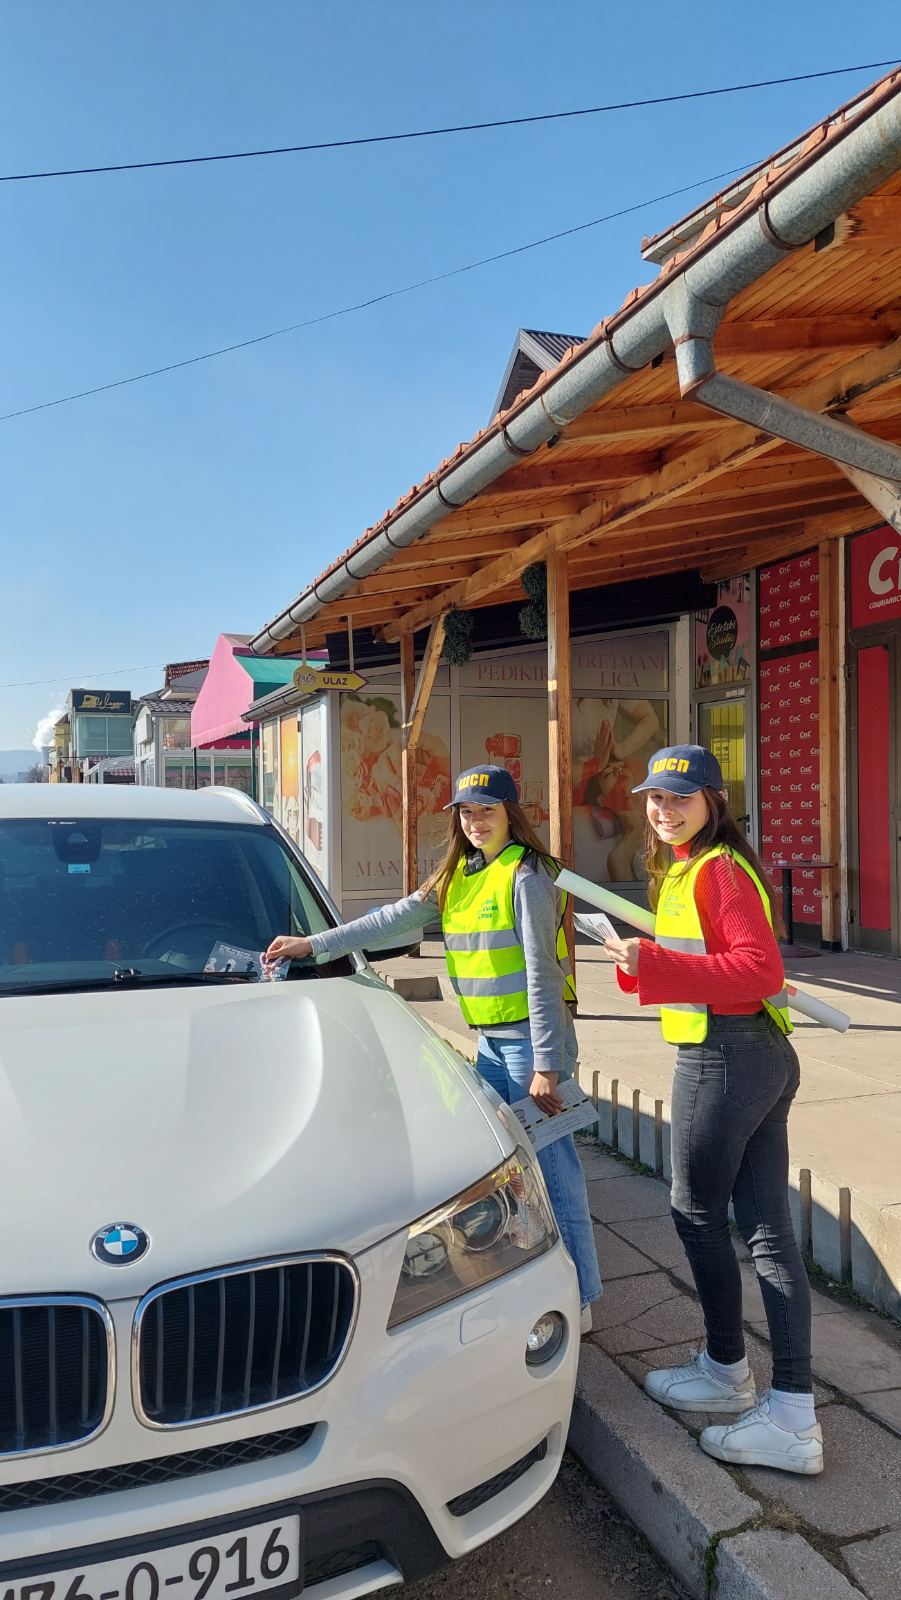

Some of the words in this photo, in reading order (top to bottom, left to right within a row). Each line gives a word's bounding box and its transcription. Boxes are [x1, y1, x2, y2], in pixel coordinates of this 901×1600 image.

[868, 546, 901, 595] С
[322, 676, 348, 685] ULAZ
[600, 671, 640, 688] LICA
[356, 859, 439, 877] MANIR
[97, 1224, 142, 1239] BMW
